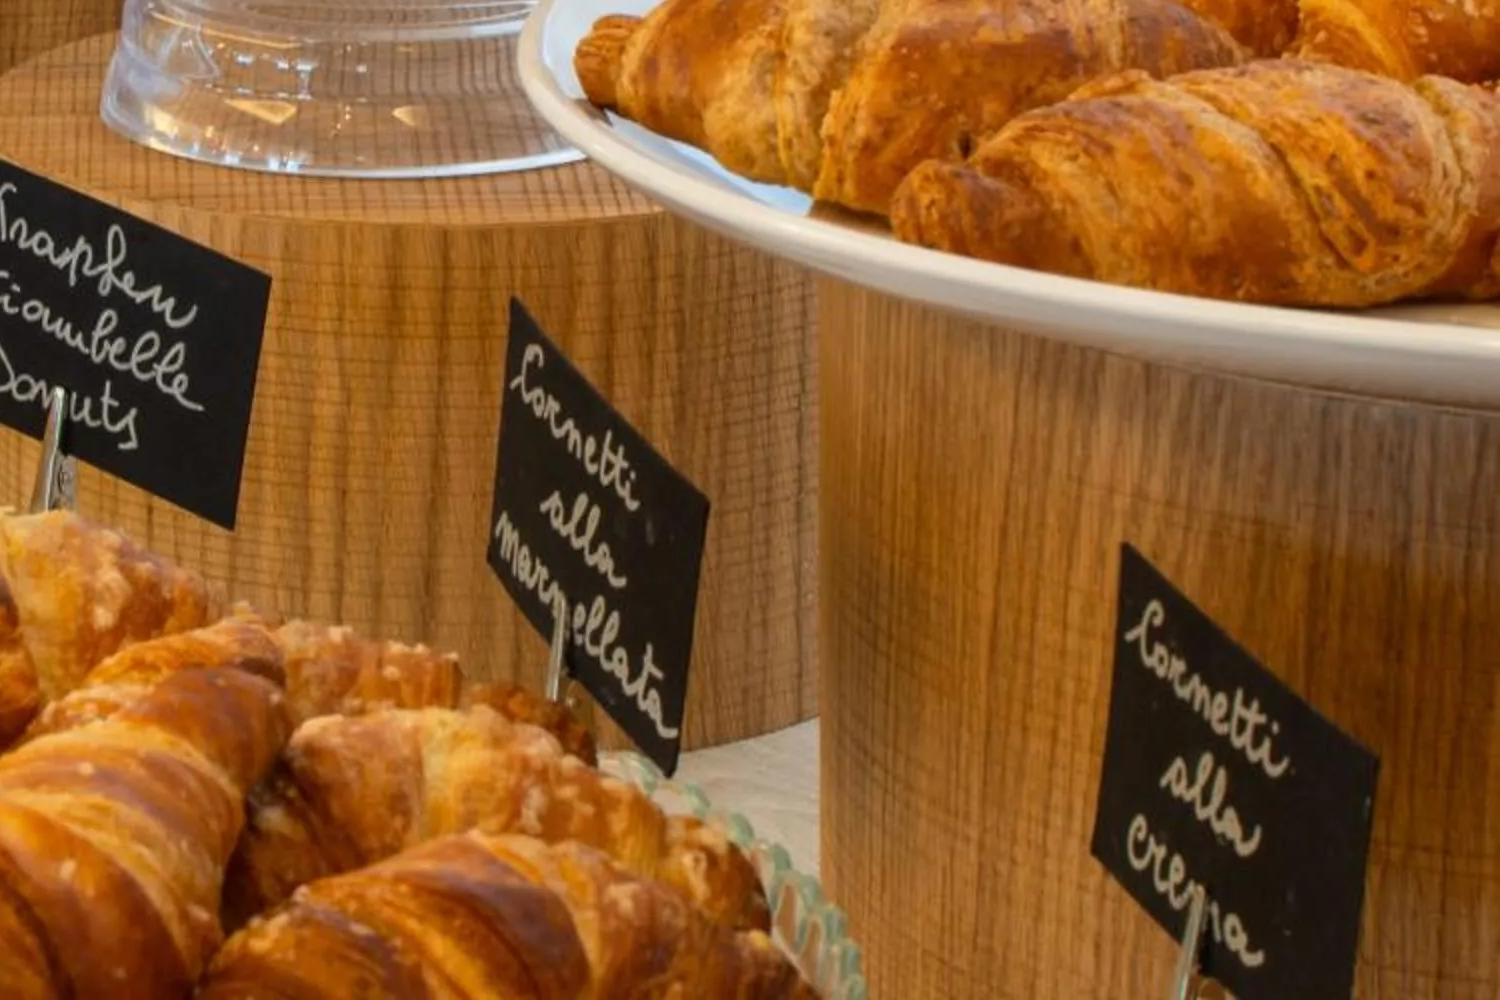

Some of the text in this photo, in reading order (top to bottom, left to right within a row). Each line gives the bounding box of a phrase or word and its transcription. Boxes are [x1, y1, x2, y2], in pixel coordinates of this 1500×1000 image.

[509, 343, 641, 512] Cornetti
[539, 490, 627, 589] alla
[1124, 599, 1290, 779] Cornetti
[1159, 751, 1263, 857] alla
